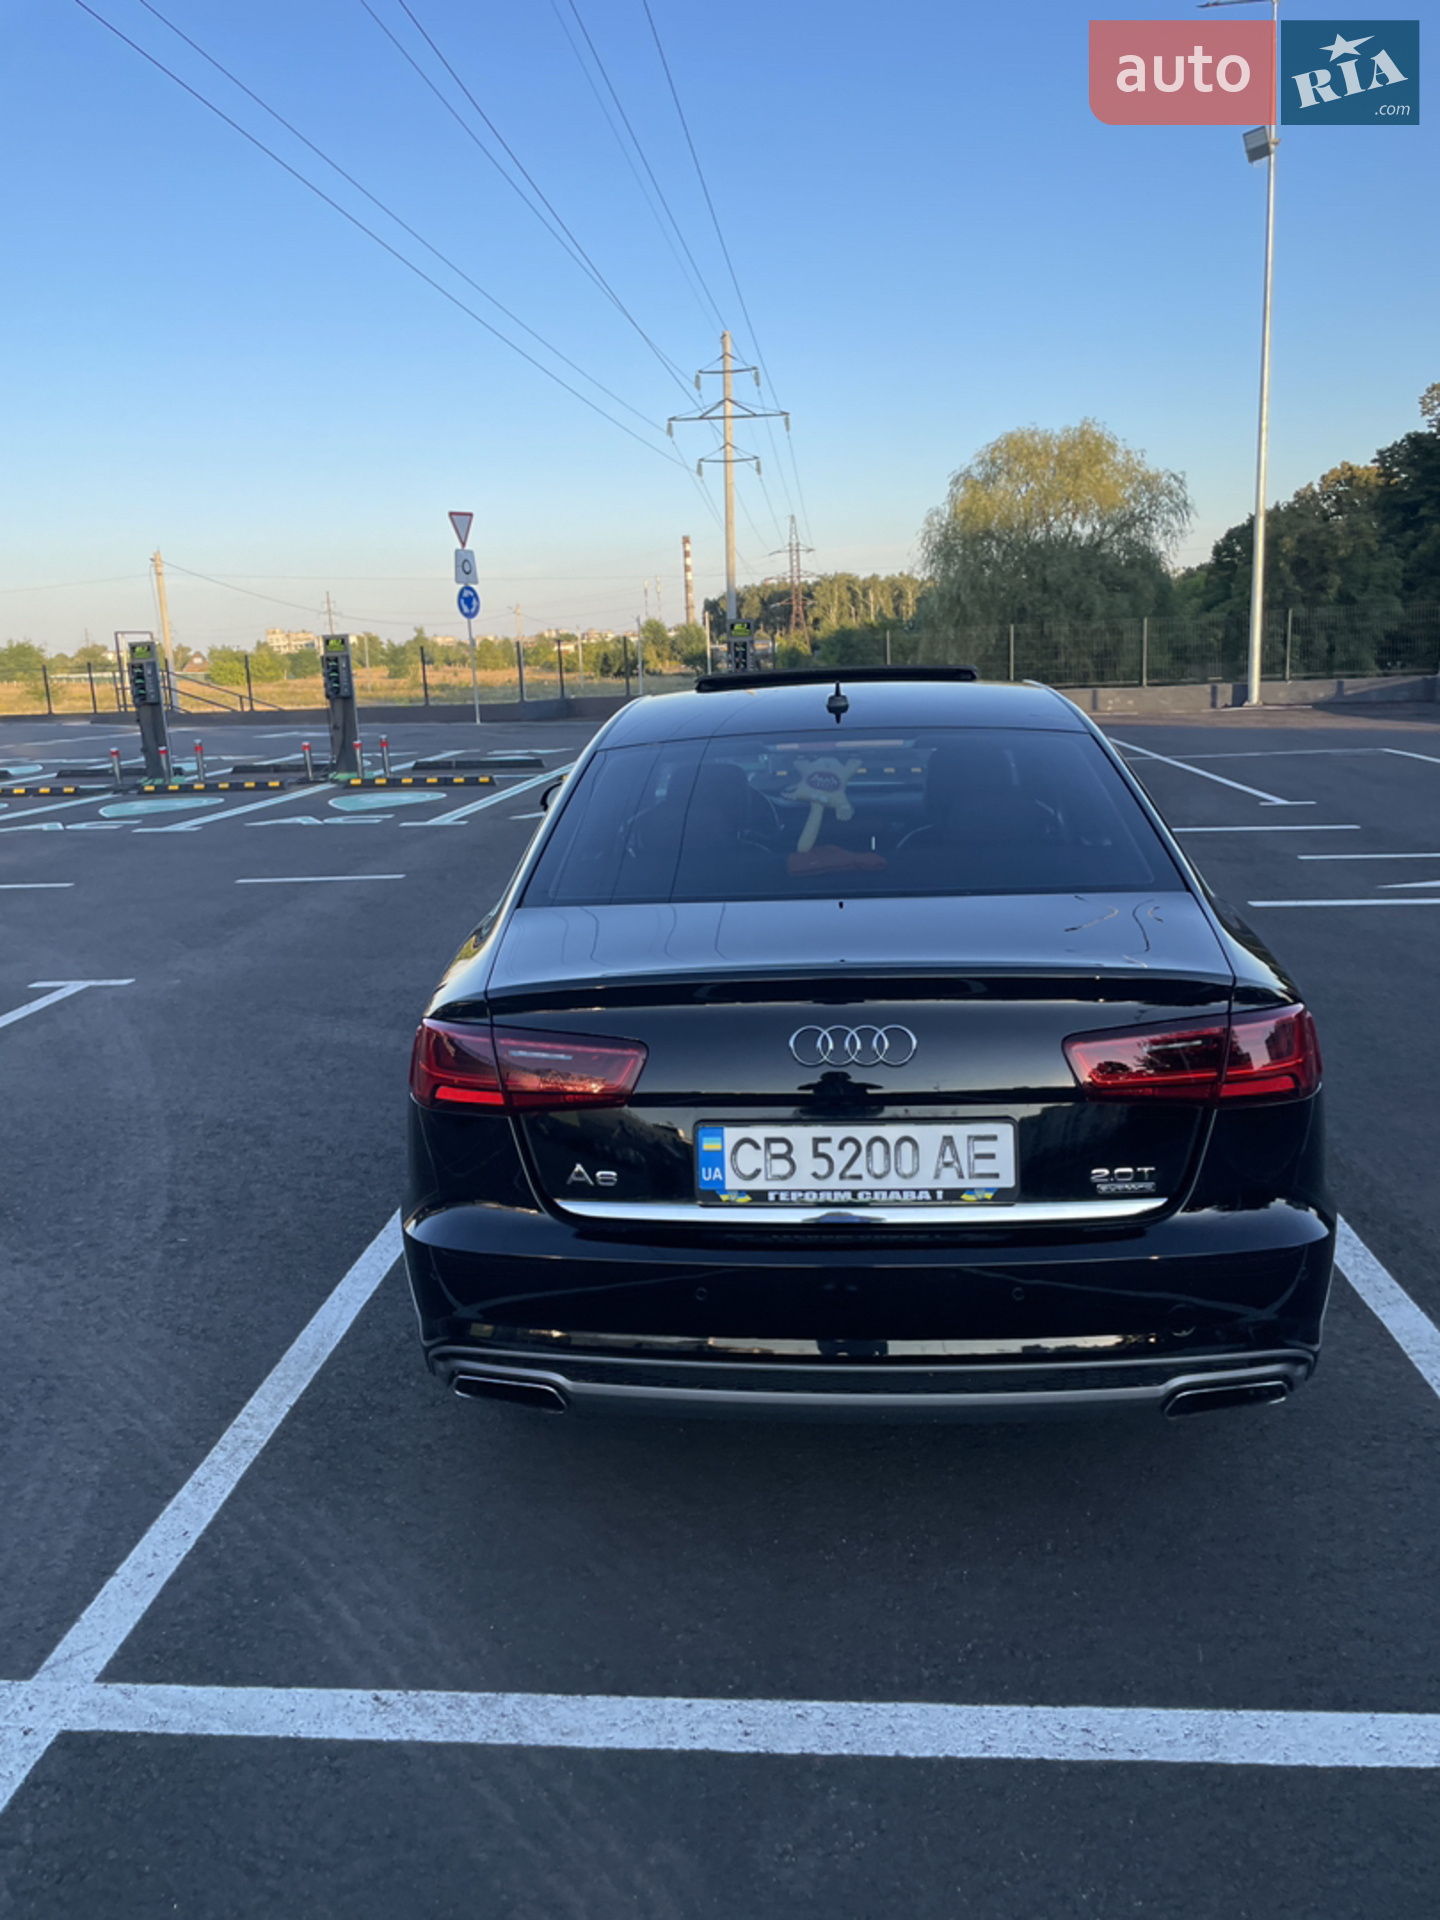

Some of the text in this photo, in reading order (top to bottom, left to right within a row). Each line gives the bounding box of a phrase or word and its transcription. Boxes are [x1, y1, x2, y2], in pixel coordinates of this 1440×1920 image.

[730, 1135, 1000, 1181] CB 5200 AE
[566, 1162, 618, 1187] A6
[702, 1167, 723, 1181] UA
[1090, 1166, 1156, 1182] 2.0T
[767, 1190, 852, 1202] ГЕРОЯМ
